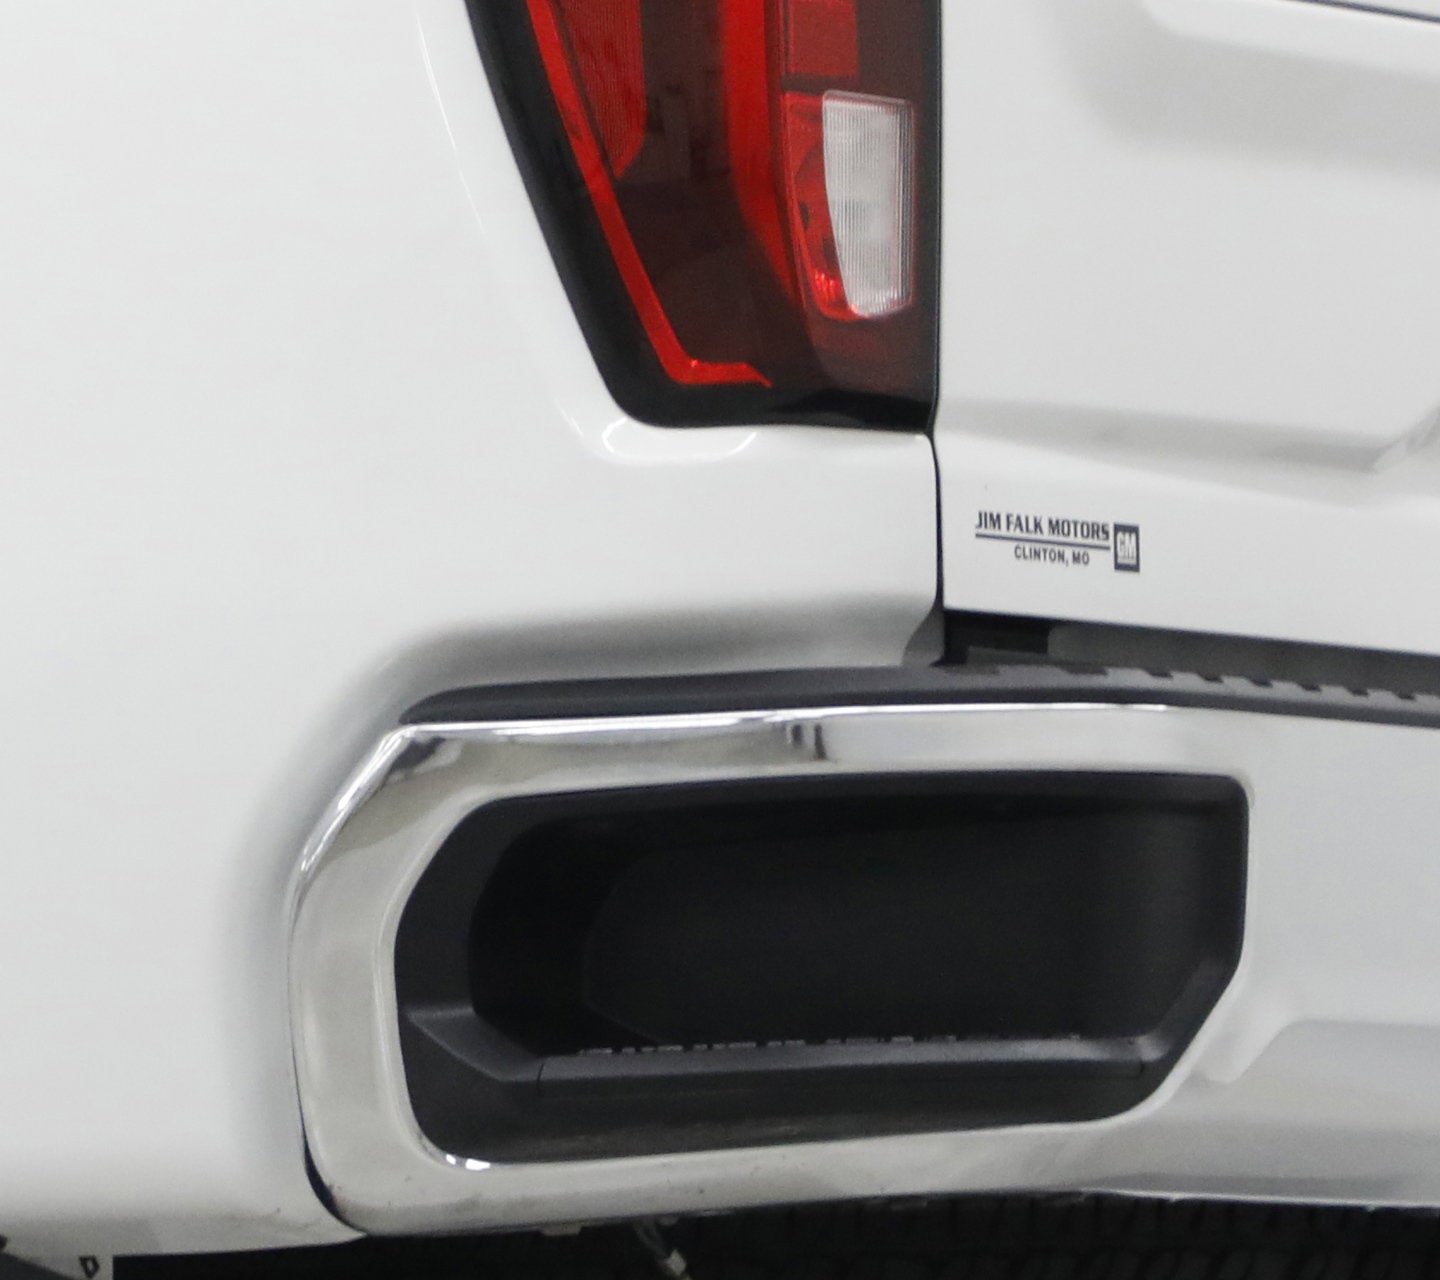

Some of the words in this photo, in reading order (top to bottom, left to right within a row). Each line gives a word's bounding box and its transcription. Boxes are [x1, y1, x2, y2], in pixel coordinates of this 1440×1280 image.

[975, 510, 1002, 530] JIM
[1006, 512, 1045, 536] FALK
[1048, 518, 1111, 542] MOTORS
[1013, 545, 1070, 567] CLINTON,
[1072, 550, 1090, 567] MO
